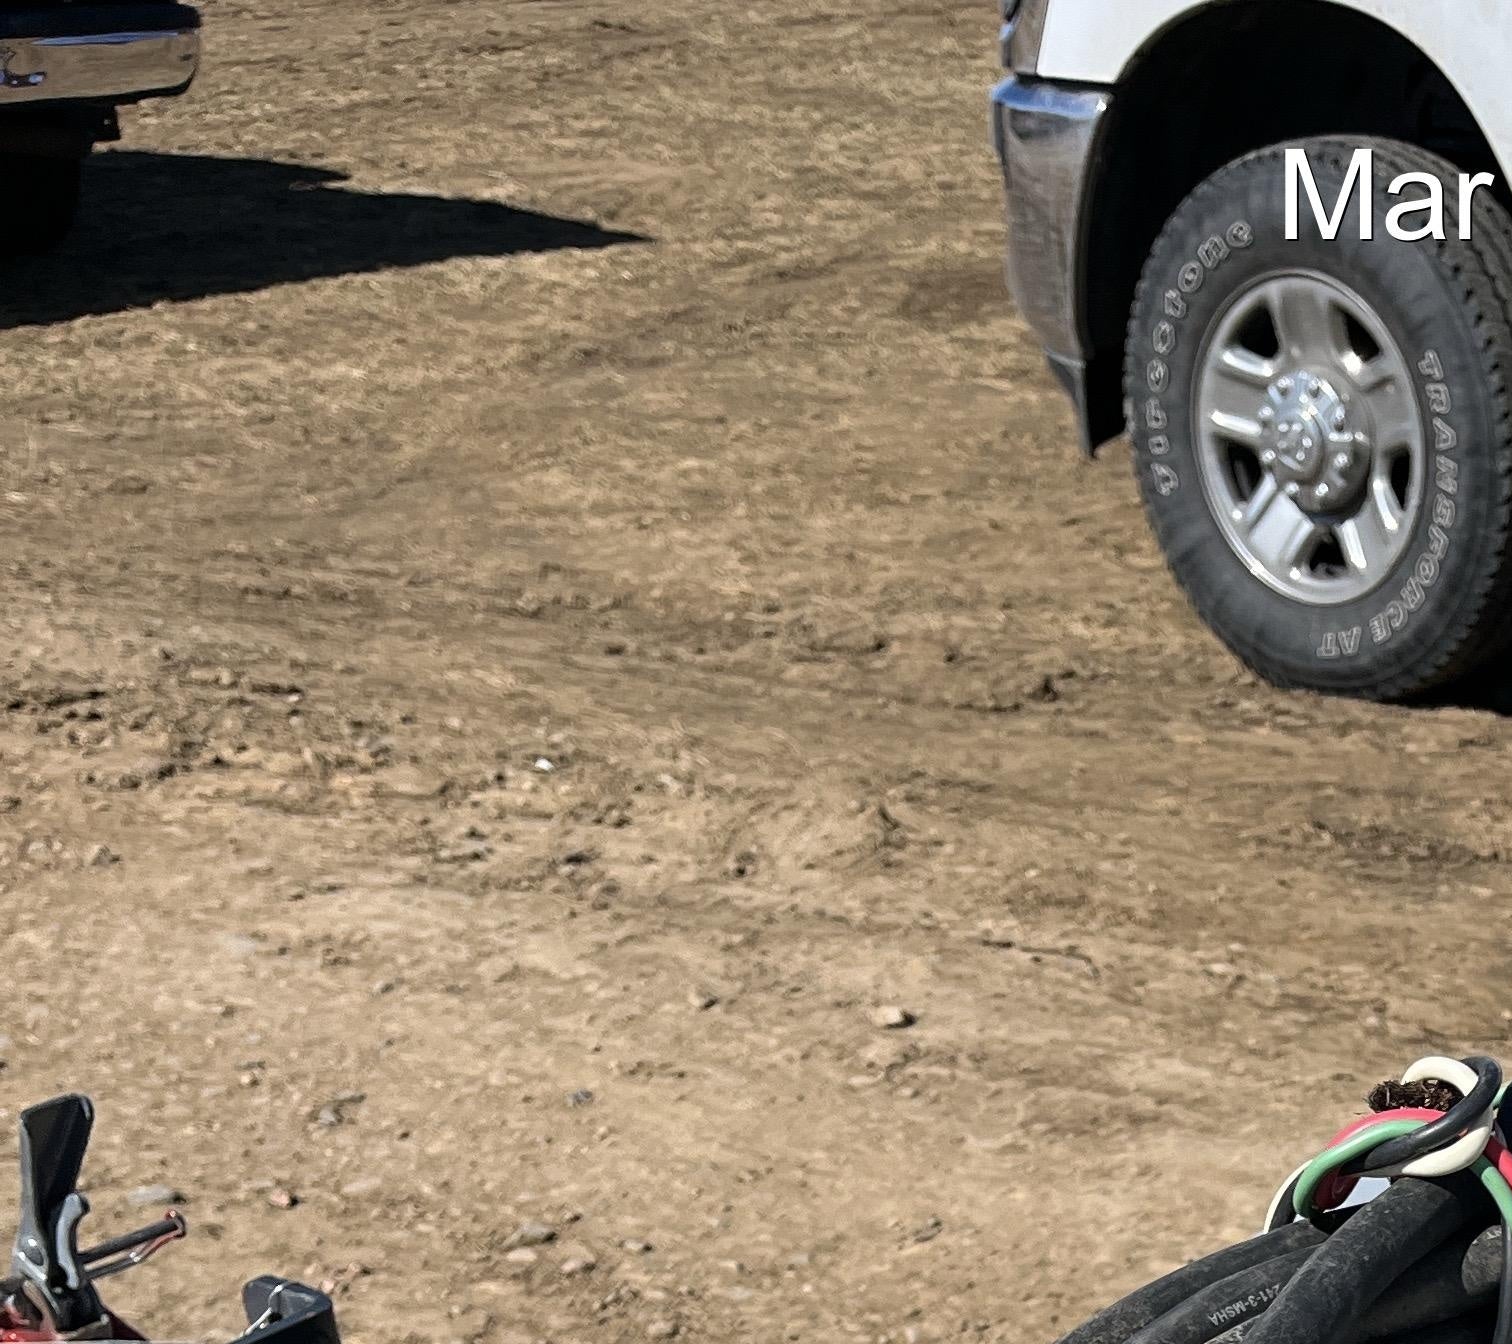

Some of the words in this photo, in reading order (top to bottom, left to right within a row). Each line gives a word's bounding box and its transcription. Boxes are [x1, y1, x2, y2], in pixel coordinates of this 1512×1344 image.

[1369, 349, 1458, 646] TRANSFORCE
[1316, 626, 1362, 659] AT
[1207, 1283, 1280, 1326] 241-3-MSHA
